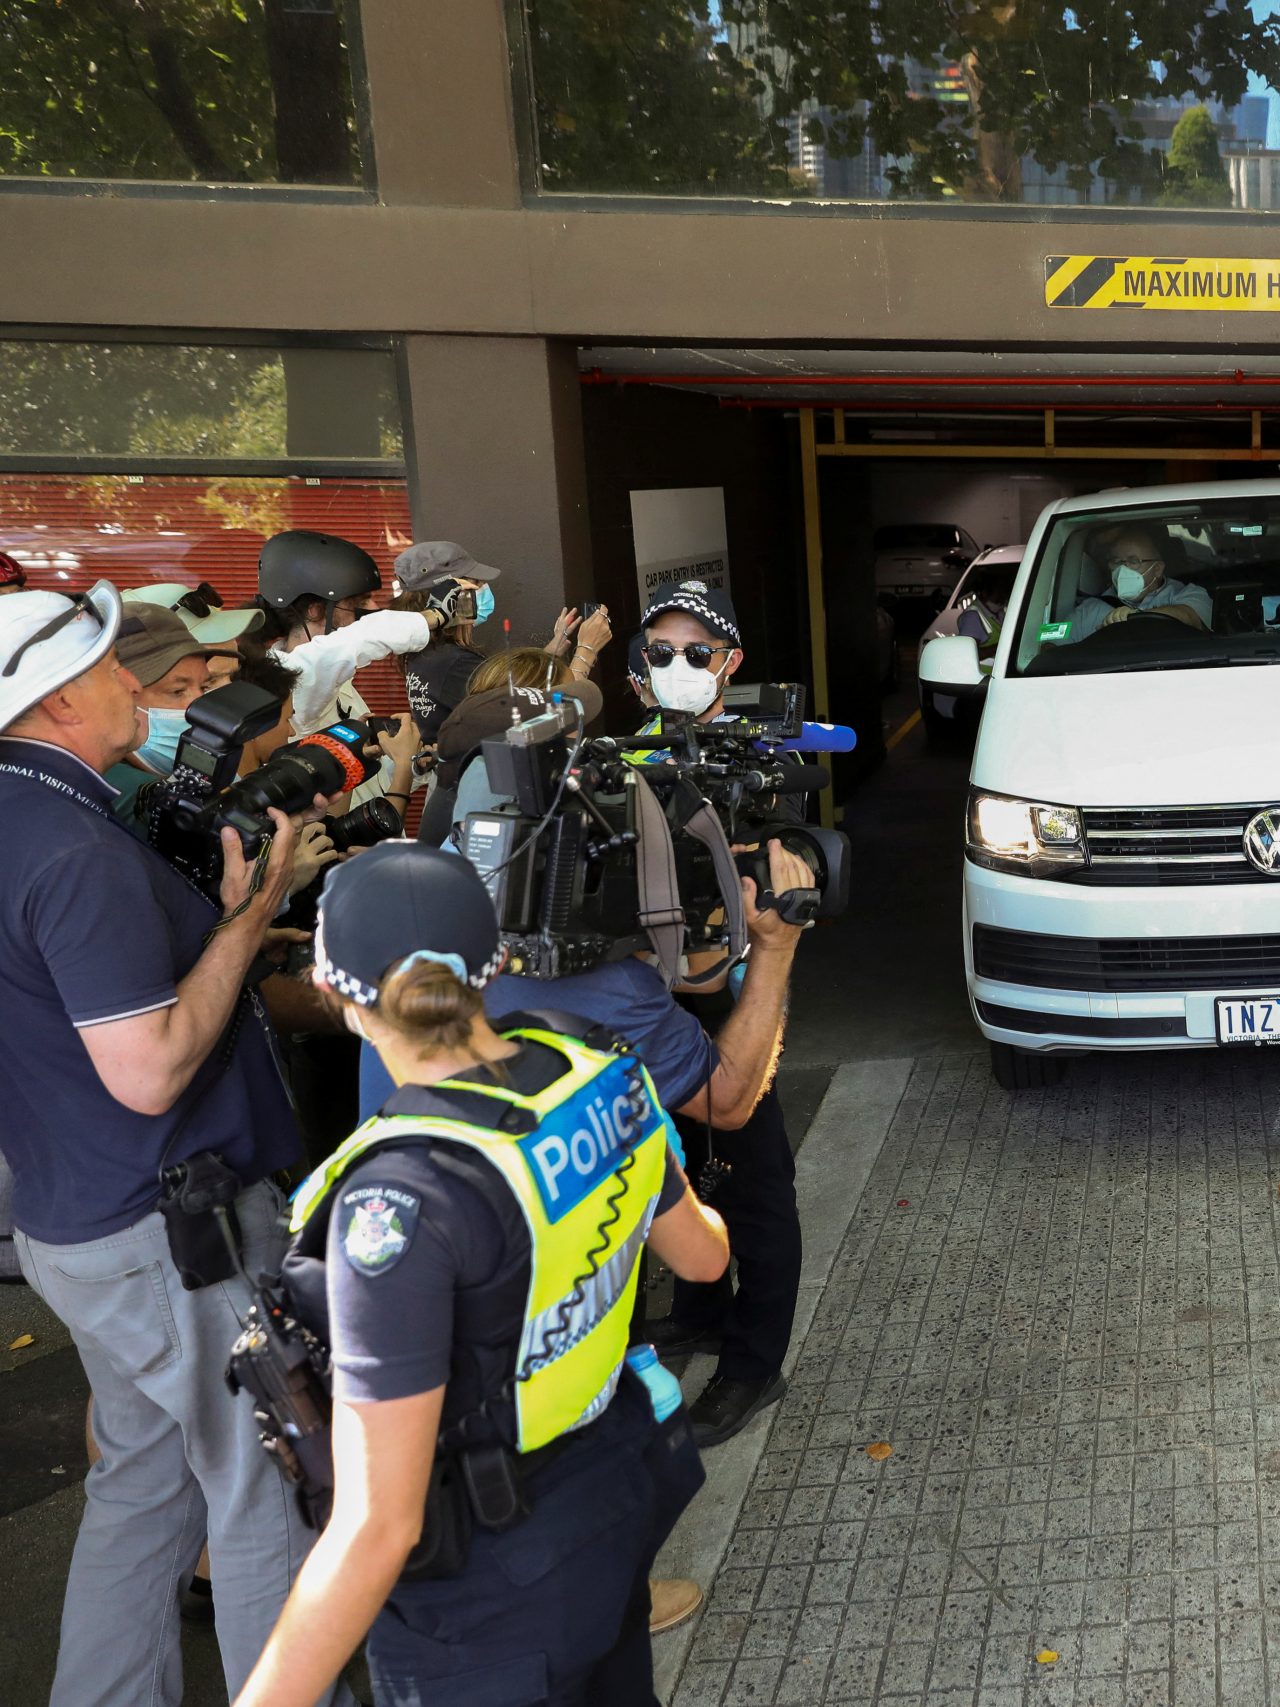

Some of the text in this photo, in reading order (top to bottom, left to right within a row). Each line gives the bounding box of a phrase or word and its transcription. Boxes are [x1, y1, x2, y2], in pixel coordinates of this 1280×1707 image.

[1124, 270, 1257, 299] MAXIMUM
[645, 572, 658, 588] CAR
[658, 569, 673, 584] PARK
[673, 567, 690, 581] ENTRY
[696, 559, 724, 576] RESTRICTED
[39, 772, 75, 795] VISITS
[75, 792, 108, 818] MEDIA
[1225, 1004, 1274, 1033] 1NZ
[1227, 1034, 1261, 1042] VICTORIA
[344, 1187, 417, 1208] VICTORIA POLICE
